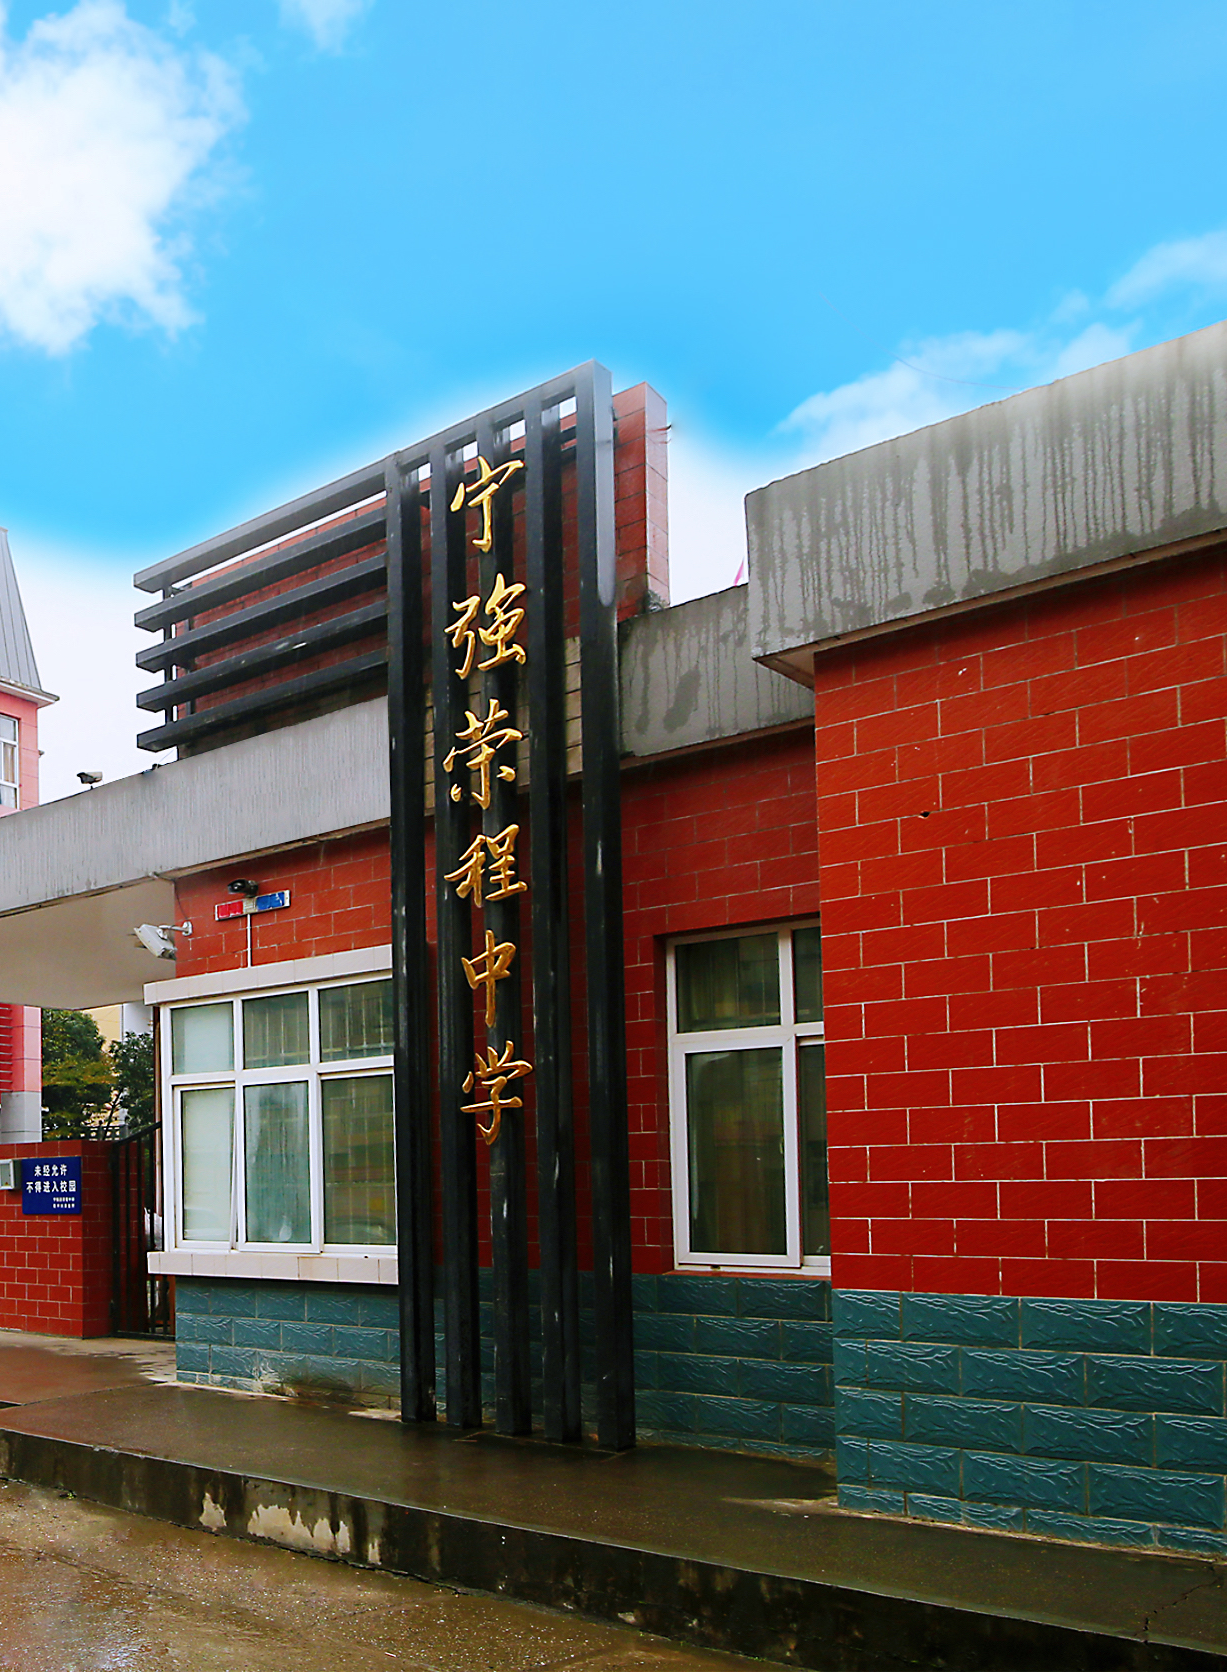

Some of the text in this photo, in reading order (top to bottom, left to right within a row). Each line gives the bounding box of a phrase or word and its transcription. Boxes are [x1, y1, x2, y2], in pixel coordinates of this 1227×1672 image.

[34, 1164, 67, 1177] 未经允许
[26, 1180, 76, 1193] 不得进入校园
